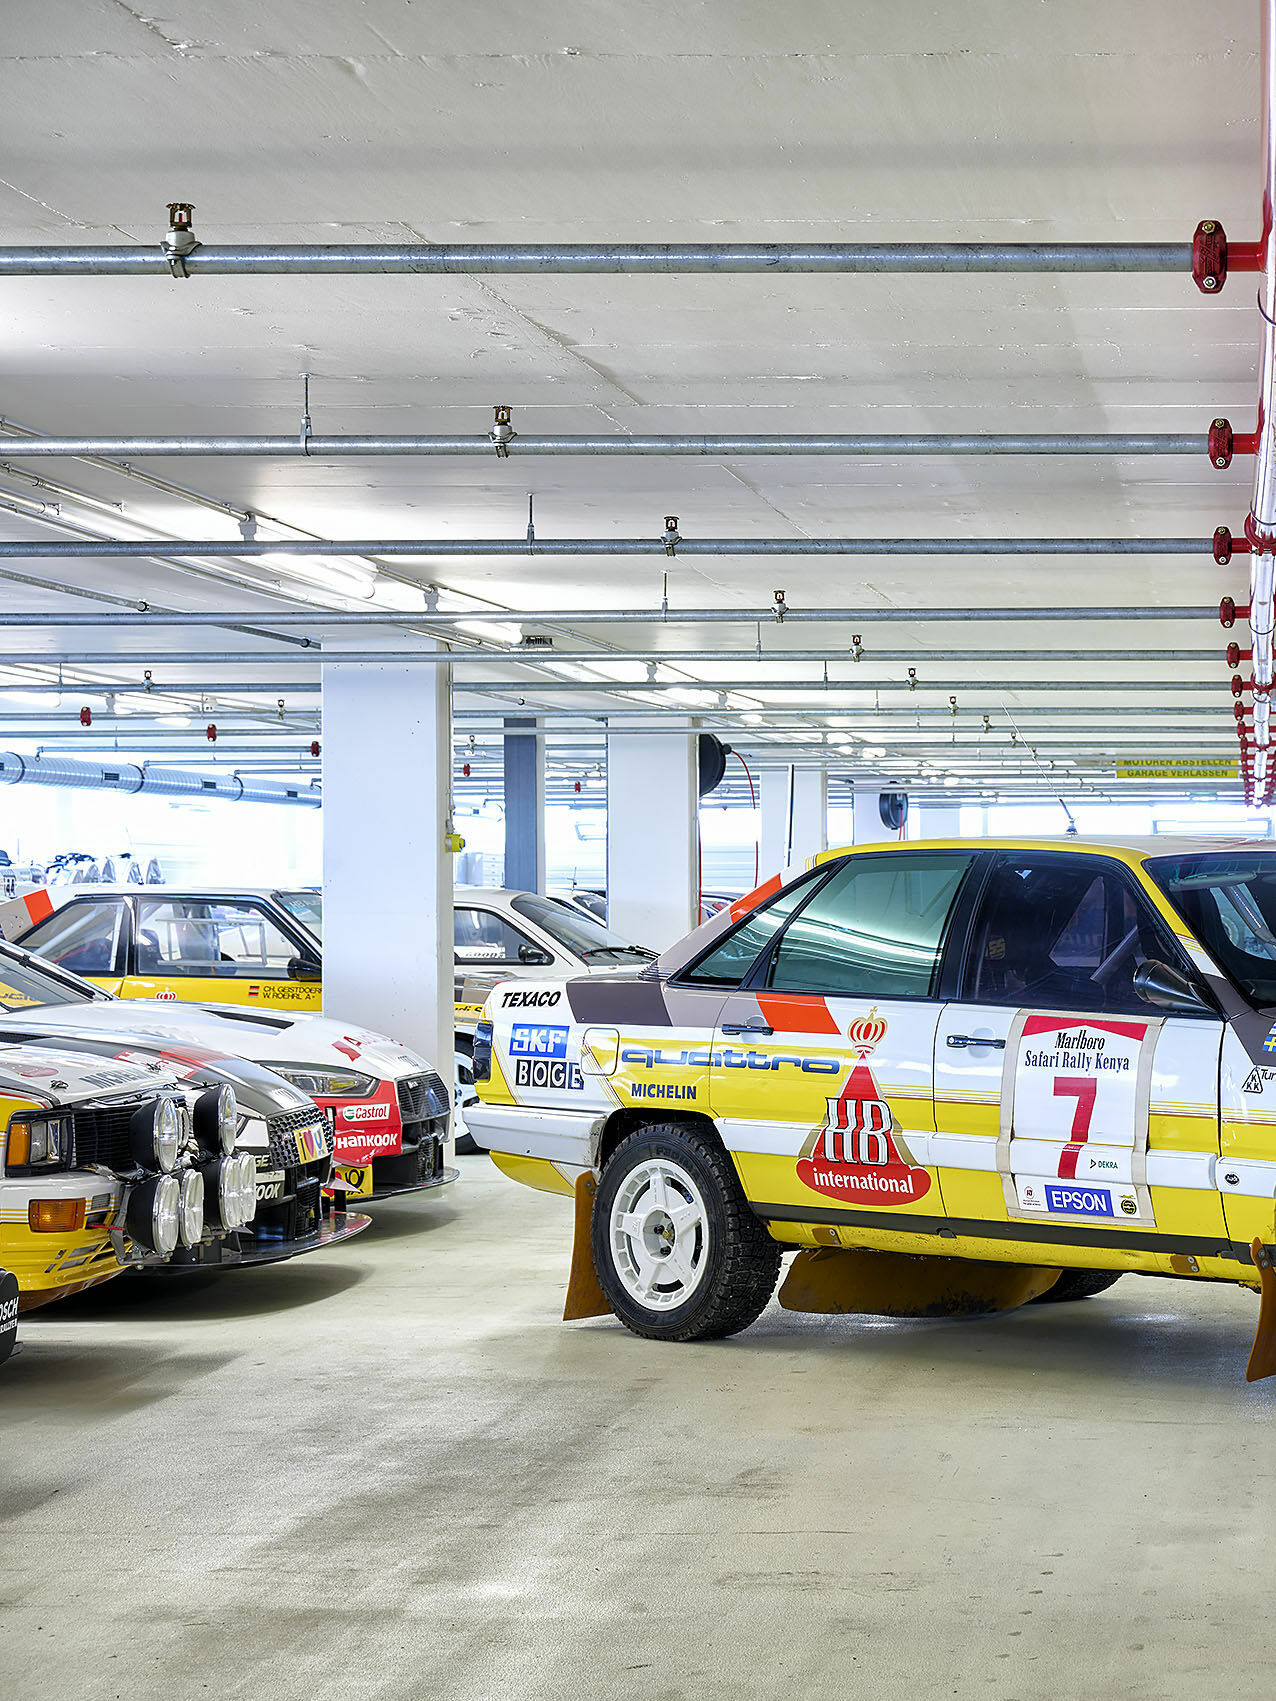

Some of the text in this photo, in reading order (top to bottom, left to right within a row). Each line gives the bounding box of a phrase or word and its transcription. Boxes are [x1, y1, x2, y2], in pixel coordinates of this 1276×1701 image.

[1127, 769, 1228, 777] GARAGE VERLASSEN
[501, 991, 562, 1008] TEXACO
[512, 1025, 568, 1053] SKF
[1054, 1029, 1106, 1050] Marlboro
[621, 1048, 841, 1075] quattro
[1024, 1050, 1130, 1074] Safari Rally Kenya
[517, 1060, 584, 1089] BOGE
[631, 1083, 697, 1100] MICHELIN
[355, 1105, 387, 1119] Castrol
[824, 1096, 893, 1167] HB
[1053, 1076, 1098, 1179] 7
[1097, 1160, 1119, 1169] DEKRA
[812, 1167, 915, 1194] international
[1050, 1189, 1108, 1212] EPSON
